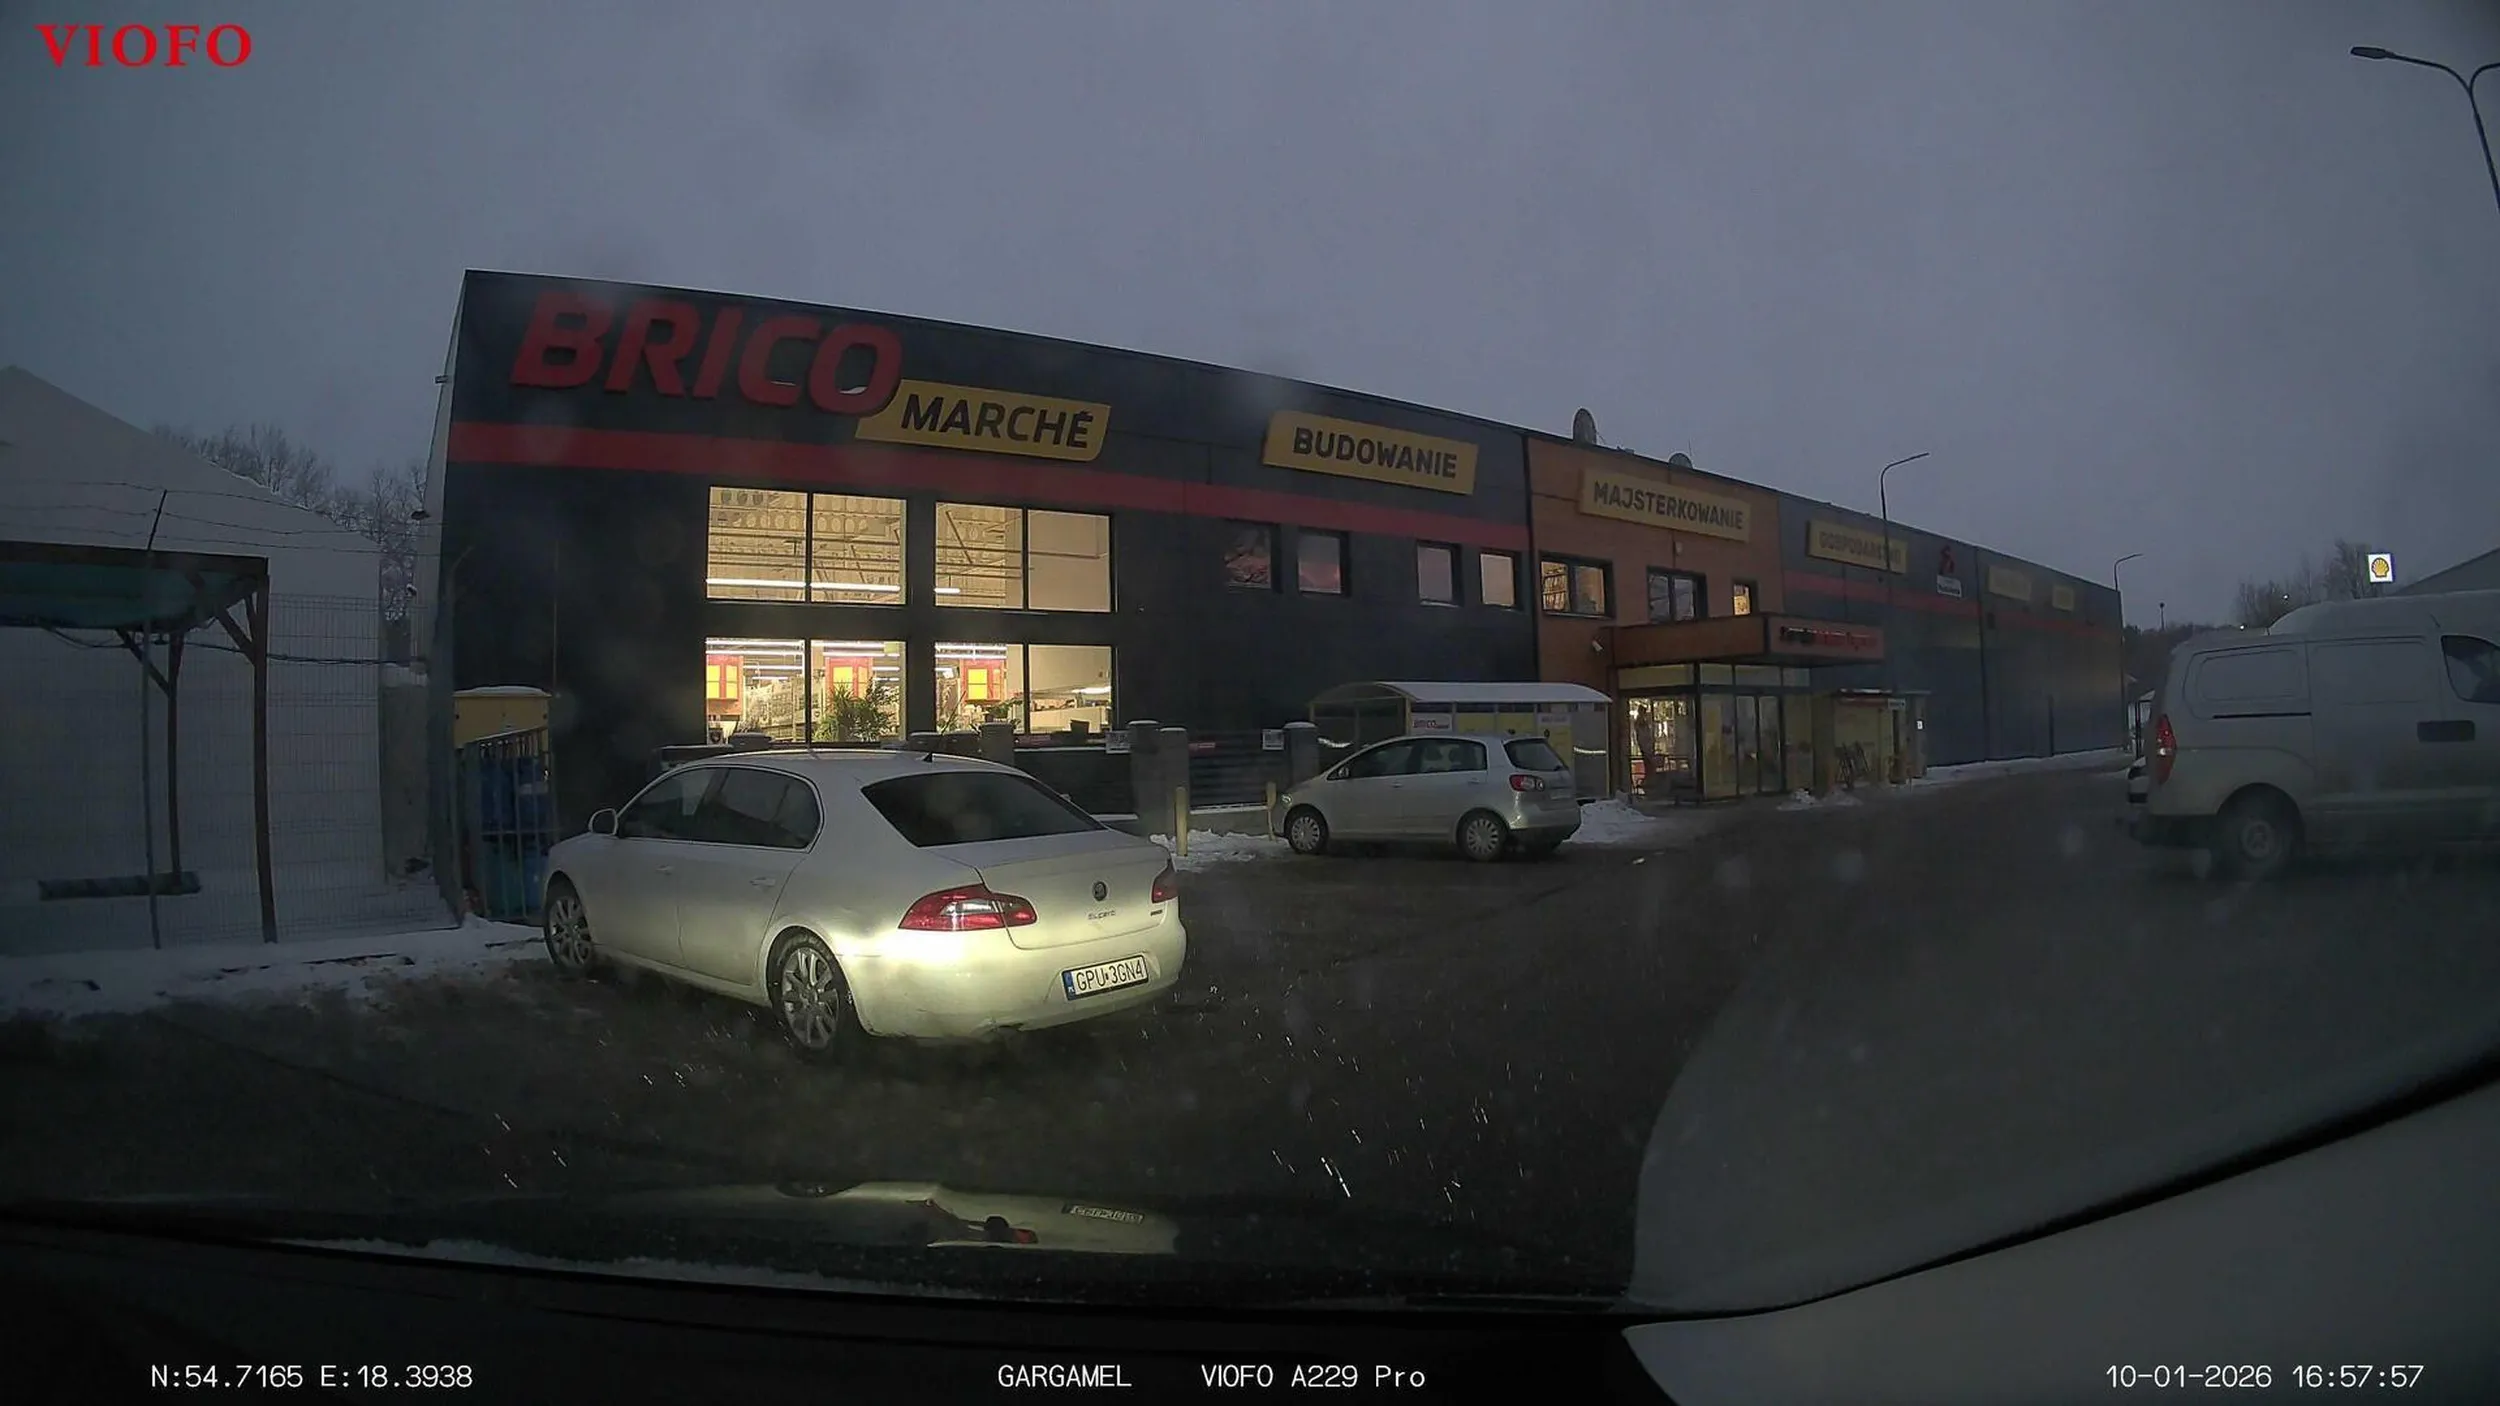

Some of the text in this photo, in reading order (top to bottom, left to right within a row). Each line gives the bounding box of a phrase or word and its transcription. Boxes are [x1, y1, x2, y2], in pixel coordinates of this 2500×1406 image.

[510, 290, 903, 417] BRICO
[900, 393, 1094, 450] MARCHÉ
[1293, 426, 1458, 478] BUDOWANIE
[1592, 479, 1744, 530] MAJSTERKOWANIE
[1076, 960, 1144, 991] GPU 3GN4
